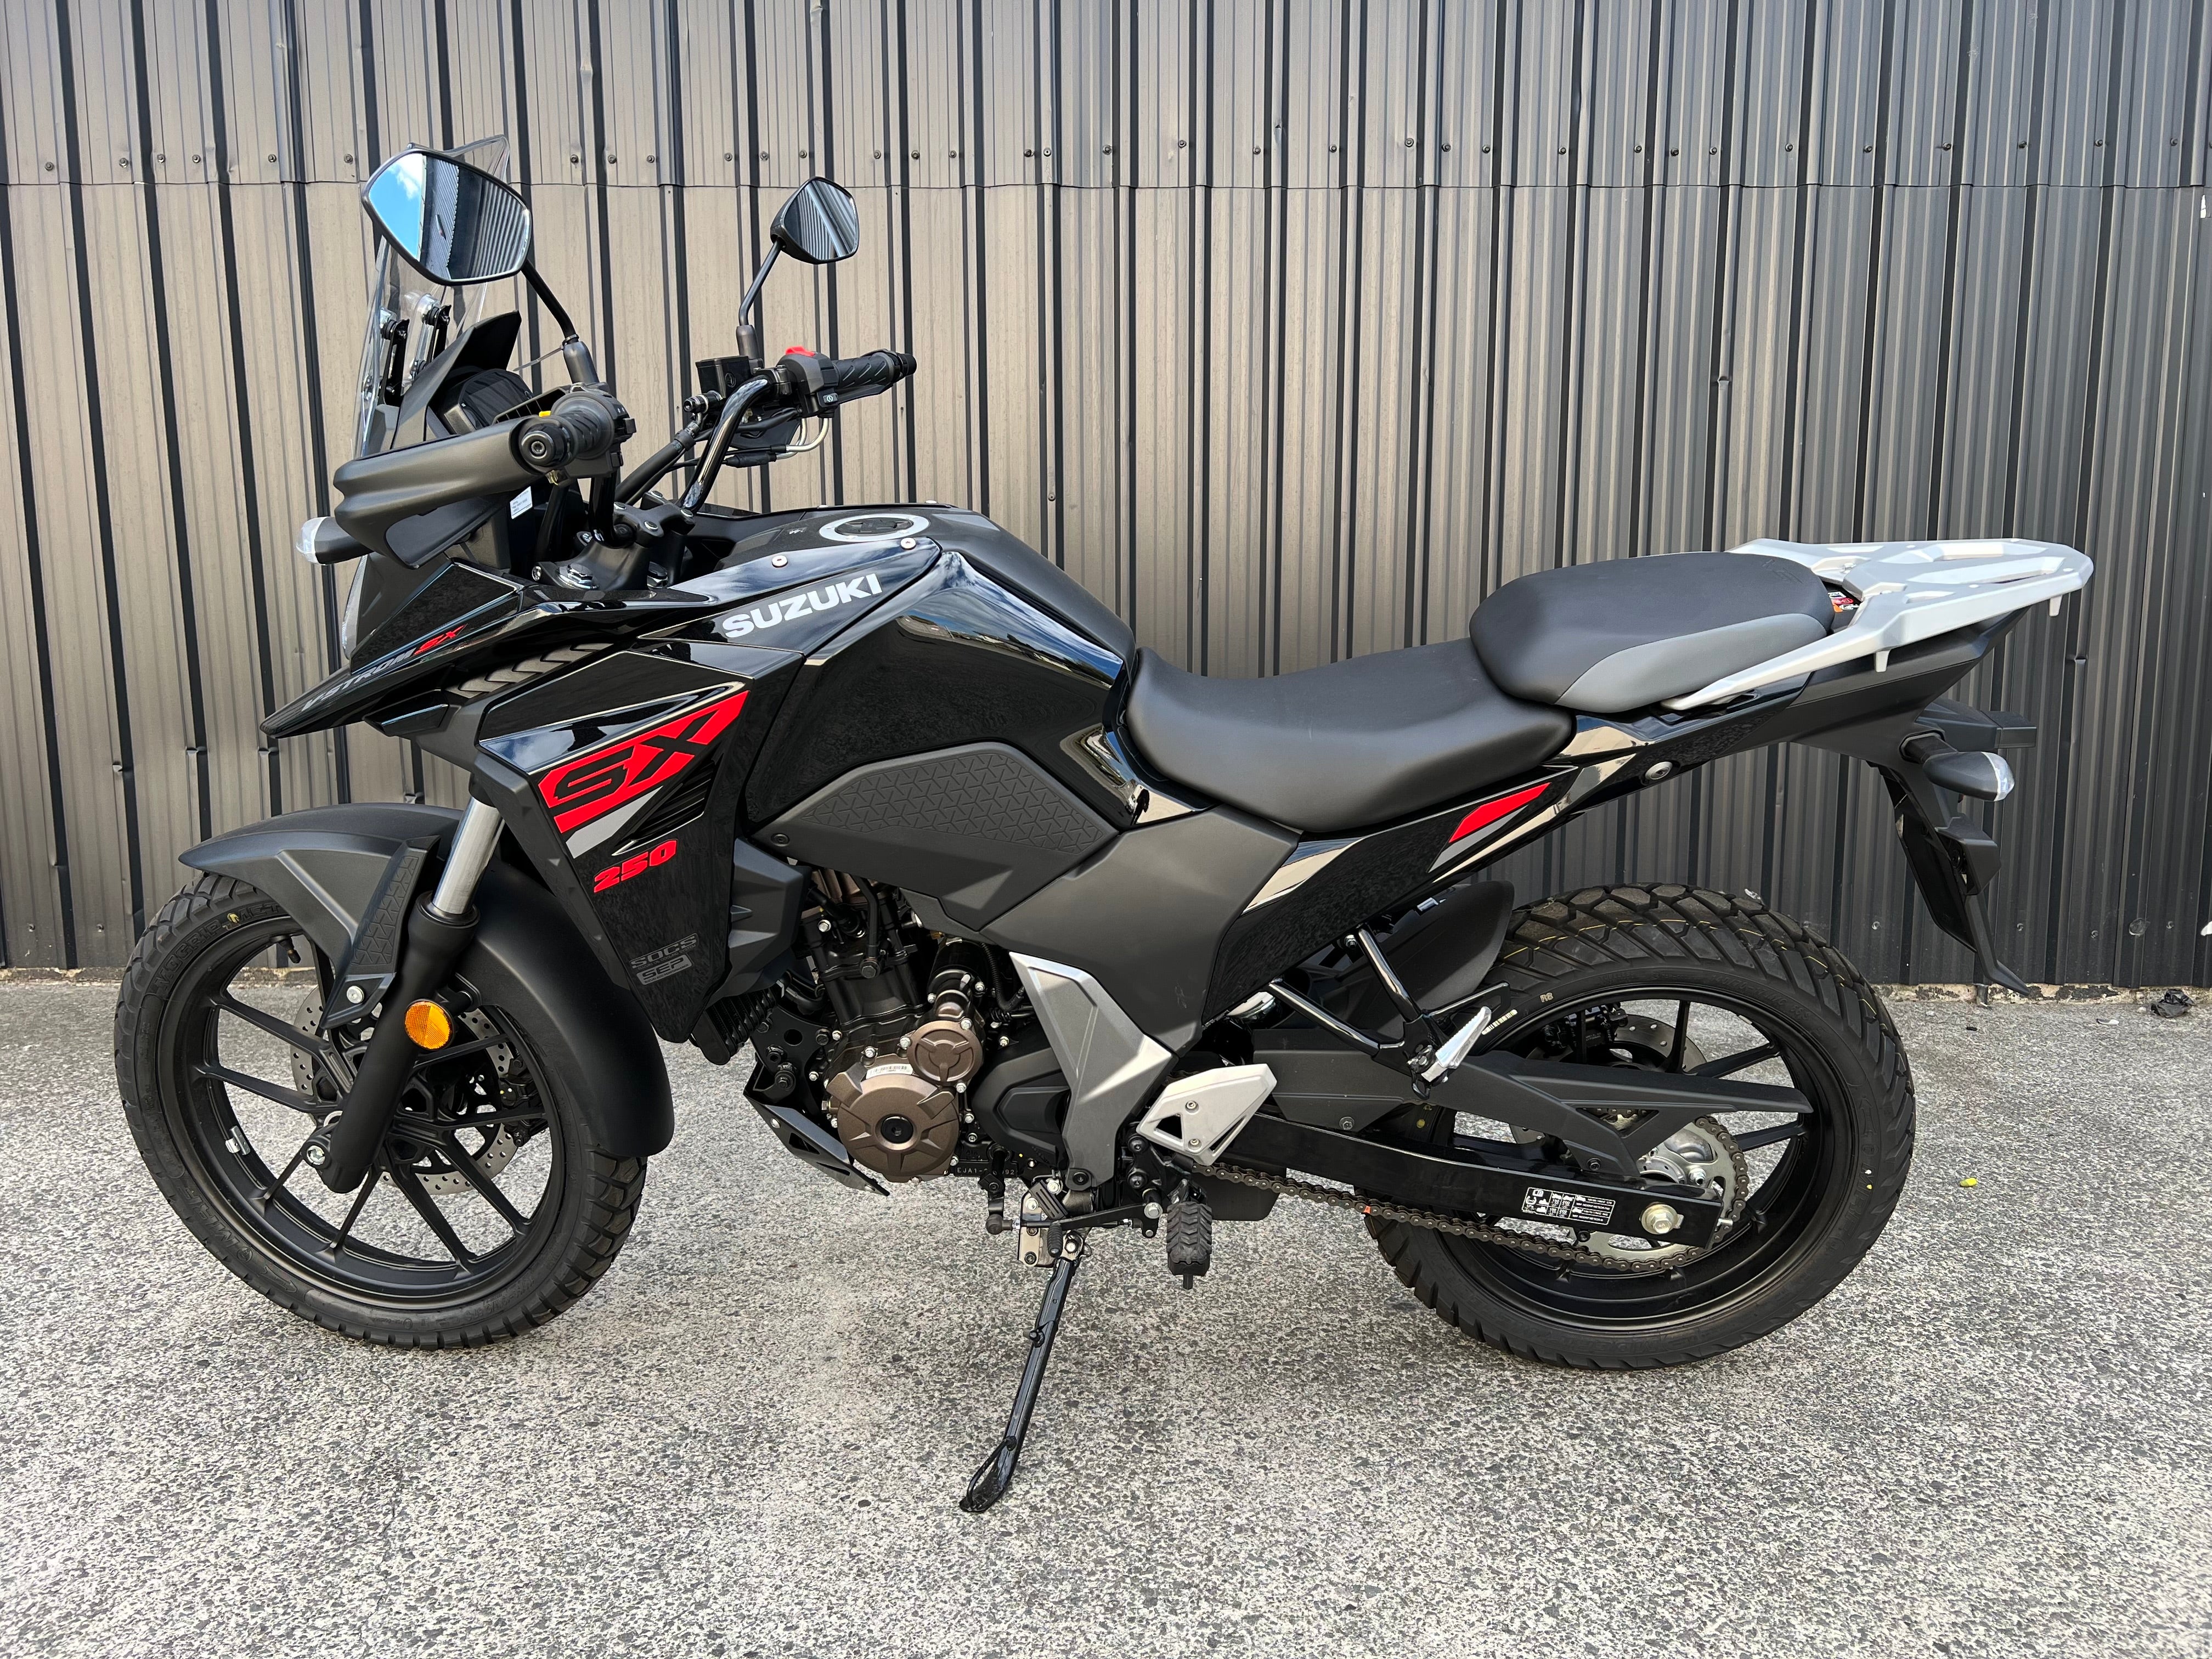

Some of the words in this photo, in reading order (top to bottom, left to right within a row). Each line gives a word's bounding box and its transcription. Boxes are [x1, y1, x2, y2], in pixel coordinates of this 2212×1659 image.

[723, 573, 882, 638] SUZUKI
[302, 647, 416, 712] V-STROM
[548, 704, 723, 818] SX
[594, 839, 678, 894] 250
[631, 935, 696, 969] SOCS
[642, 957, 684, 980] SEP
[179, 1184, 240, 1249] MRF
